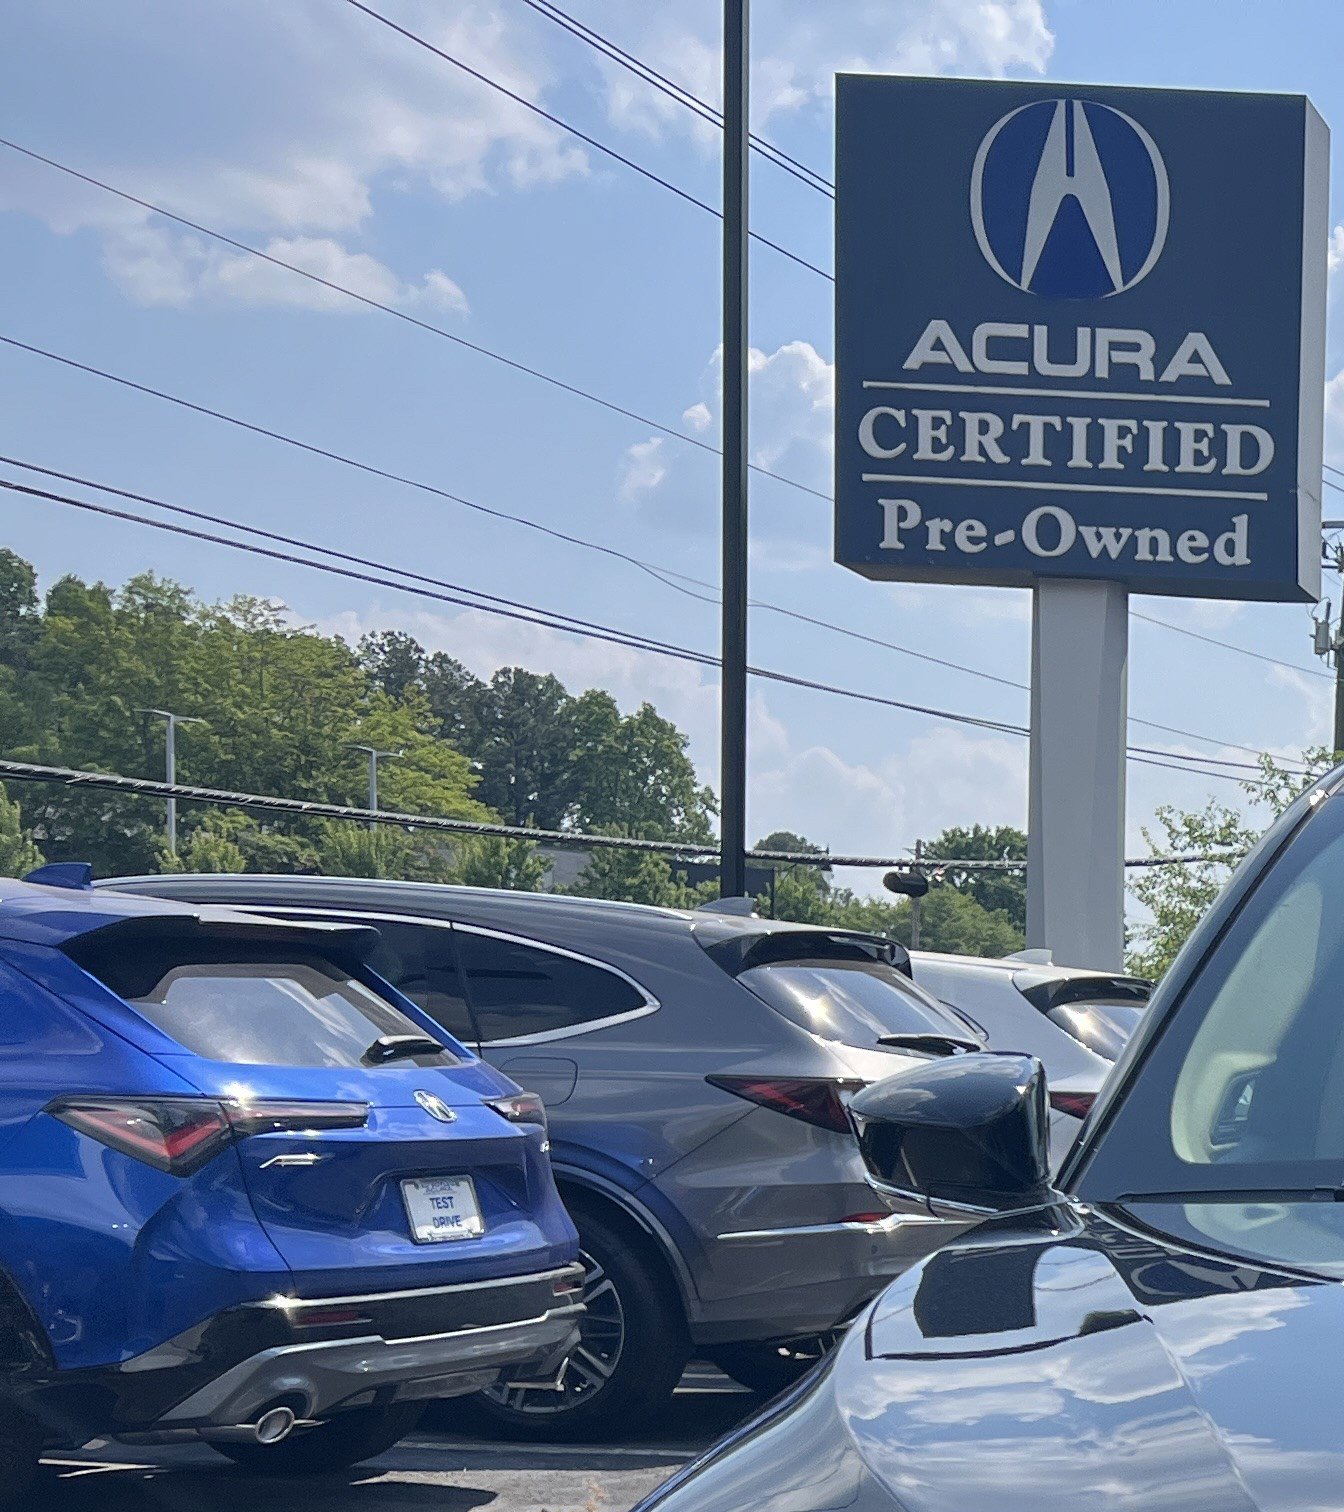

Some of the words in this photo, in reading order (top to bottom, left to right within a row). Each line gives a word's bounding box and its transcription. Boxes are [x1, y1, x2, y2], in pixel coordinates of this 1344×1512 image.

[902, 319, 1232, 386] ACURA
[858, 406, 1275, 477] CERTIFIED
[878, 498, 1252, 566] Pre-Owned
[429, 1196, 454, 1210] TEST
[432, 1214, 462, 1229] DRIVE
